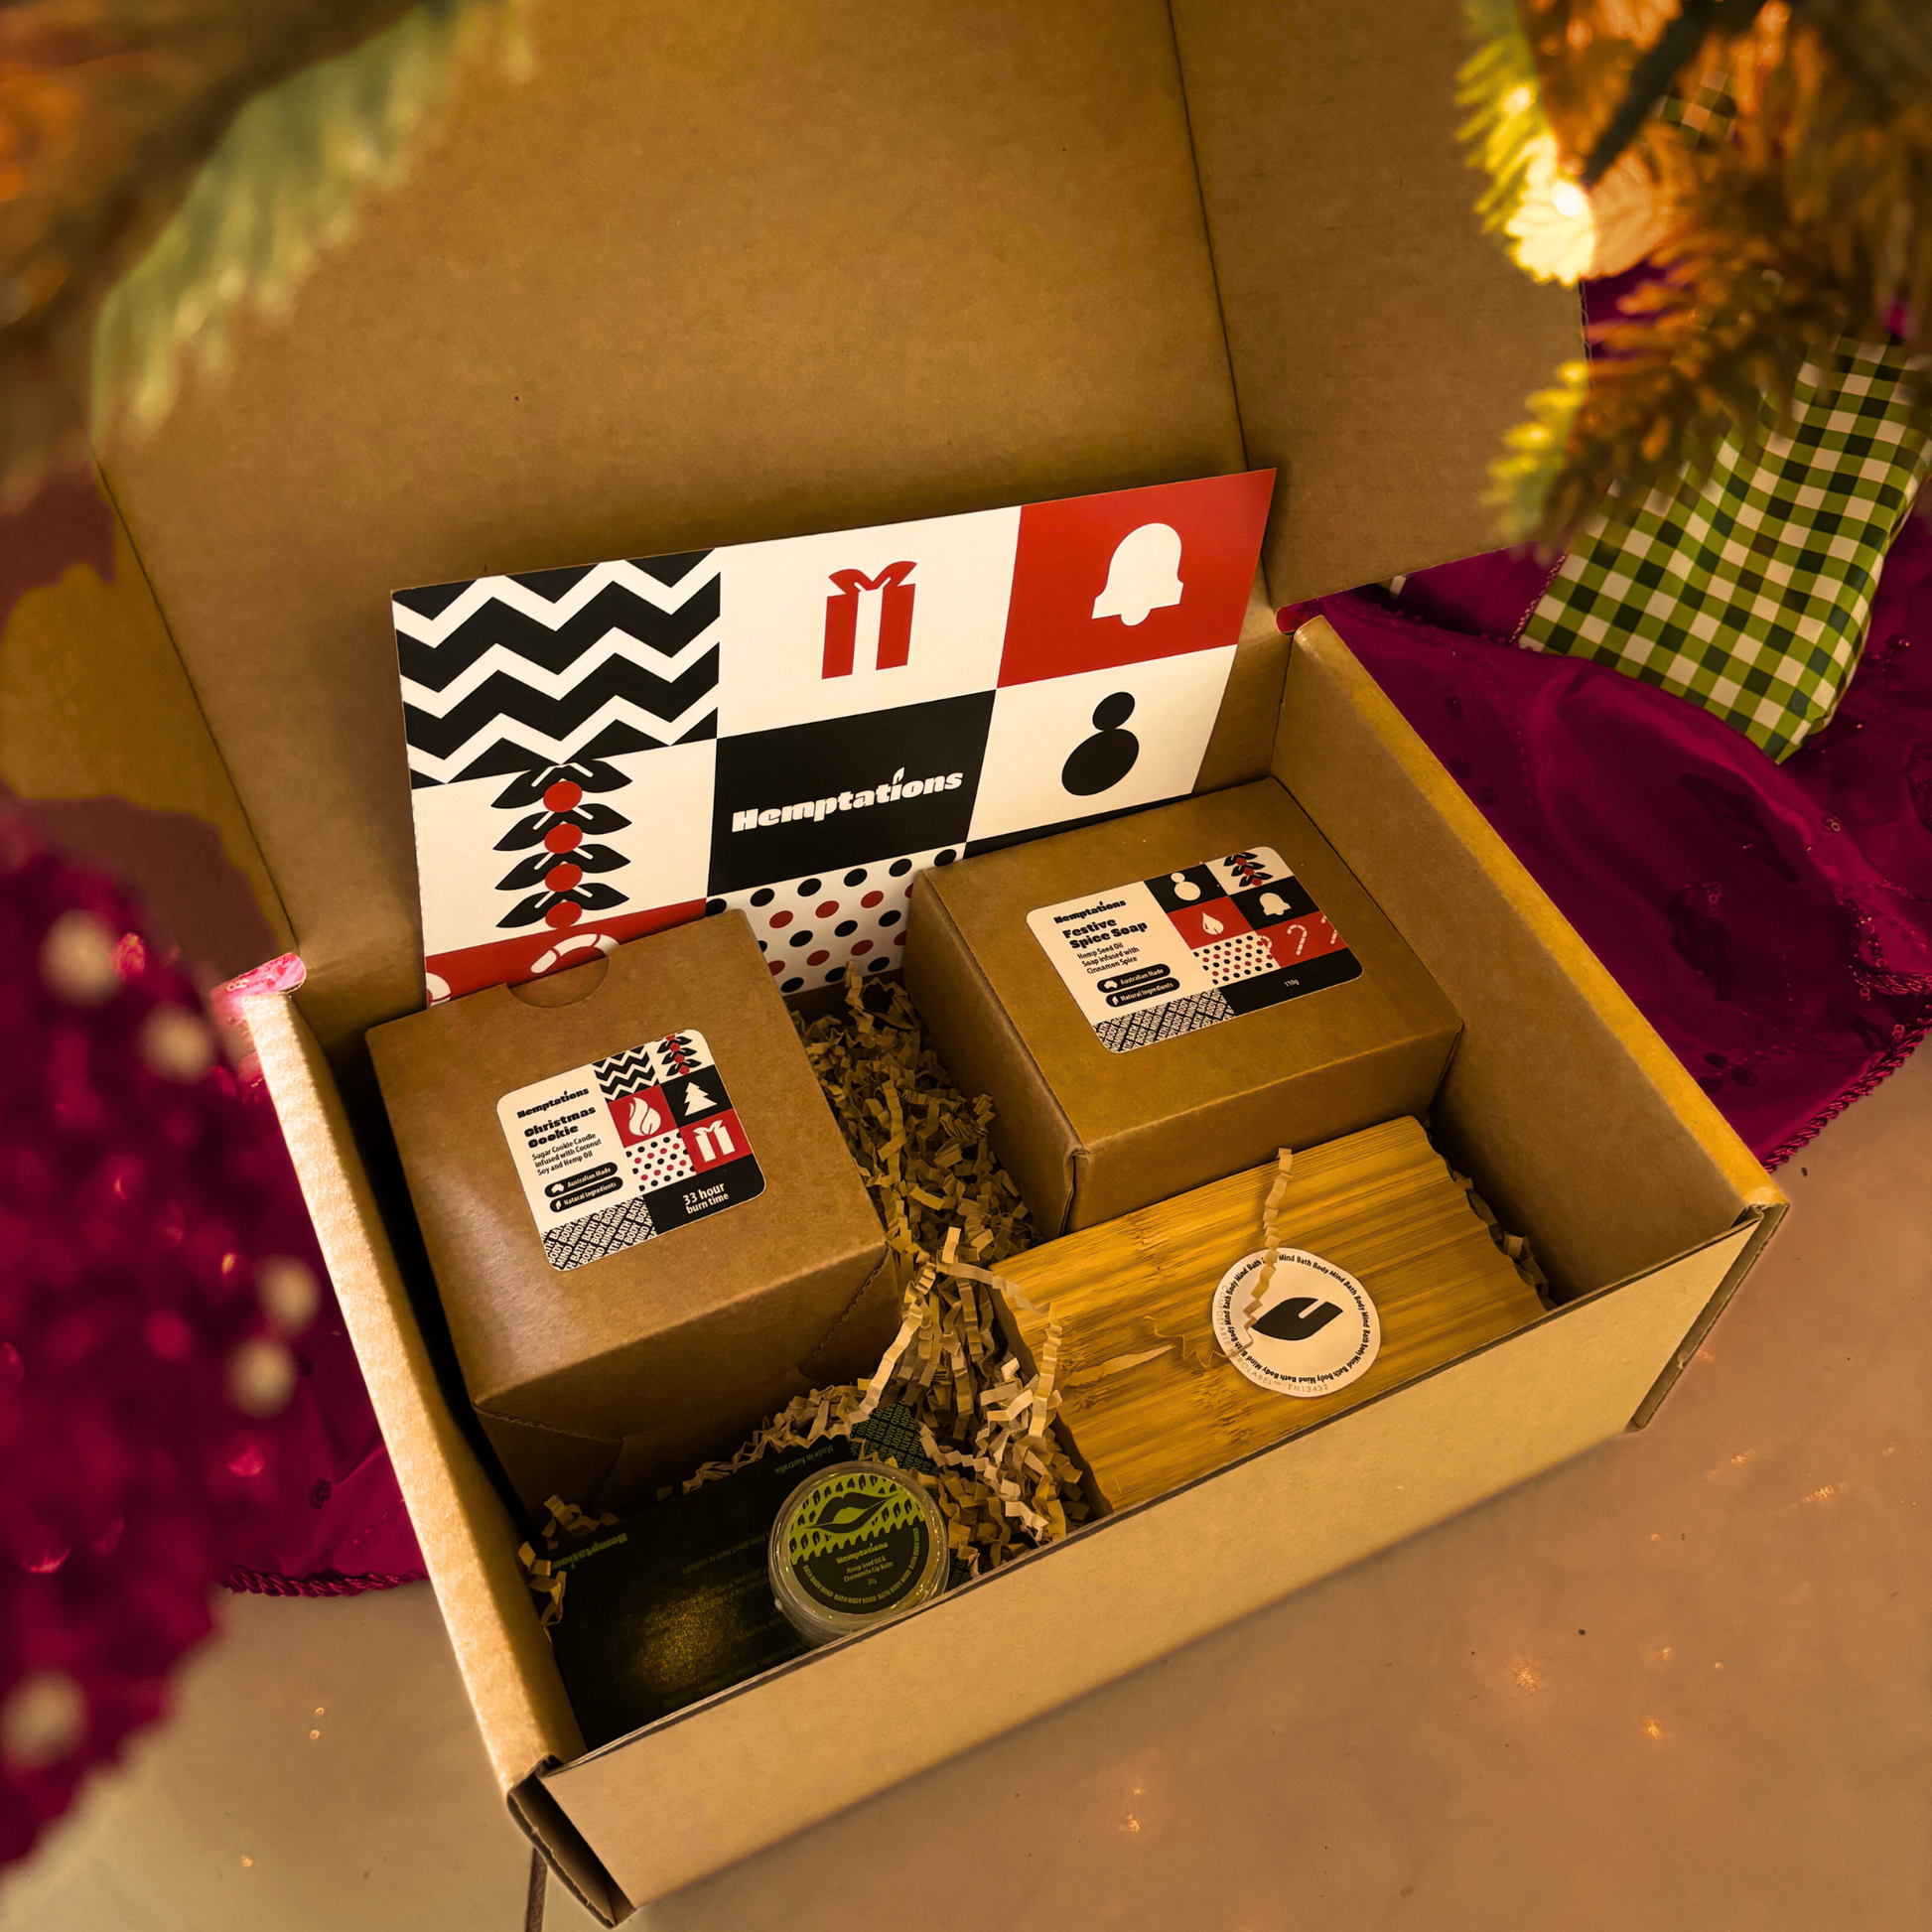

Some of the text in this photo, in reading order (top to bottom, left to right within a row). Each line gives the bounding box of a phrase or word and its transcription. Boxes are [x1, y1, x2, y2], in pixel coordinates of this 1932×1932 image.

[732, 766, 963, 832] Hemptations
[1053, 900, 1126, 924] Hemptations
[1062, 918, 1117, 939] Festive
[1069, 921, 1148, 949] Spice Soap
[1077, 950, 1098, 960] Hemp
[1098, 944, 1114, 955] Seed
[1082, 946, 1140, 968] Soap infused with
[1086, 956, 1138, 975] Cinnamon Spice
[1120, 967, 1164, 986] Australian Made
[1284, 978, 1301, 988] 110g
[1120, 981, 1173, 1003] Natural Ingredients
[517, 1090, 590, 1119] Hemptations
[524, 1107, 596, 1138] Christmas
[528, 1125, 579, 1149] Cookie
[532, 1133, 597, 1162] Sugar Cookie Candle
[560, 1149, 576, 1160] with
[576, 1139, 603, 1154] Coconut
[537, 1151, 594, 1176] Soy and Hemp Oil
[567, 1167, 612, 1187] Australian Made
[563, 1181, 617, 1206] Natural Ingredients
[682, 1182, 726, 1206] 33 hour
[685, 1191, 730, 1215] burn time
[600, 1226, 617, 1248] MIND
[610, 1207, 627, 1228] MIND
[615, 1220, 632, 1241] BATH
[625, 1199, 643, 1220] BATH
[570, 1241, 587, 1262] BATH
[581, 1220, 599, 1242] BATH
[590, 1222, 608, 1244] BODY
[623, 1222, 640, 1244] BODY
[1246, 1258, 1262, 1271] Bath
[1296, 1256, 1311, 1267] Bath
[1311, 1263, 1328, 1275] Body
[1233, 1267, 1249, 1282] Mind
[1328, 1270, 1346, 1283] Mind
[1225, 1280, 1239, 1296] Body
[1343, 1281, 1357, 1296] Bath
[1222, 1295, 1232, 1310] Bath
[1353, 1295, 1366, 1311] Body
[1223, 1311, 1232, 1325] Mind
[1361, 1311, 1370, 1328] Mind
[1227, 1325, 1239, 1342] Body
[1234, 1341, 1249, 1357] Bth
[1245, 1355, 1263, 1371] Mind
[1332, 1365, 1349, 1378] Bath
[1261, 1366, 1280, 1380] Body
[1280, 1374, 1297, 1383] Bath
[1298, 1376, 1316, 1385] Mind
[1316, 1372, 1334, 1383] Body
[1288, 1383, 1328, 1393] EN13432
[814, 1445, 834, 1457] Made
[774, 1456, 806, 1474] Australia
[551, 1532, 628, 1570] Hemptation
[836, 1542, 889, 1565] Hemptations
[802, 1564, 813, 1579] BATH
[810, 1576, 822, 1589] BODY
[820, 1586, 834, 1597] MIND
[833, 1593, 848, 1603] BATH
[862, 1595, 877, 1604] MIND
[877, 1587, 892, 1600] BATH
[890, 1581, 903, 1593] BODY
[899, 1569, 912, 1584] MIND
